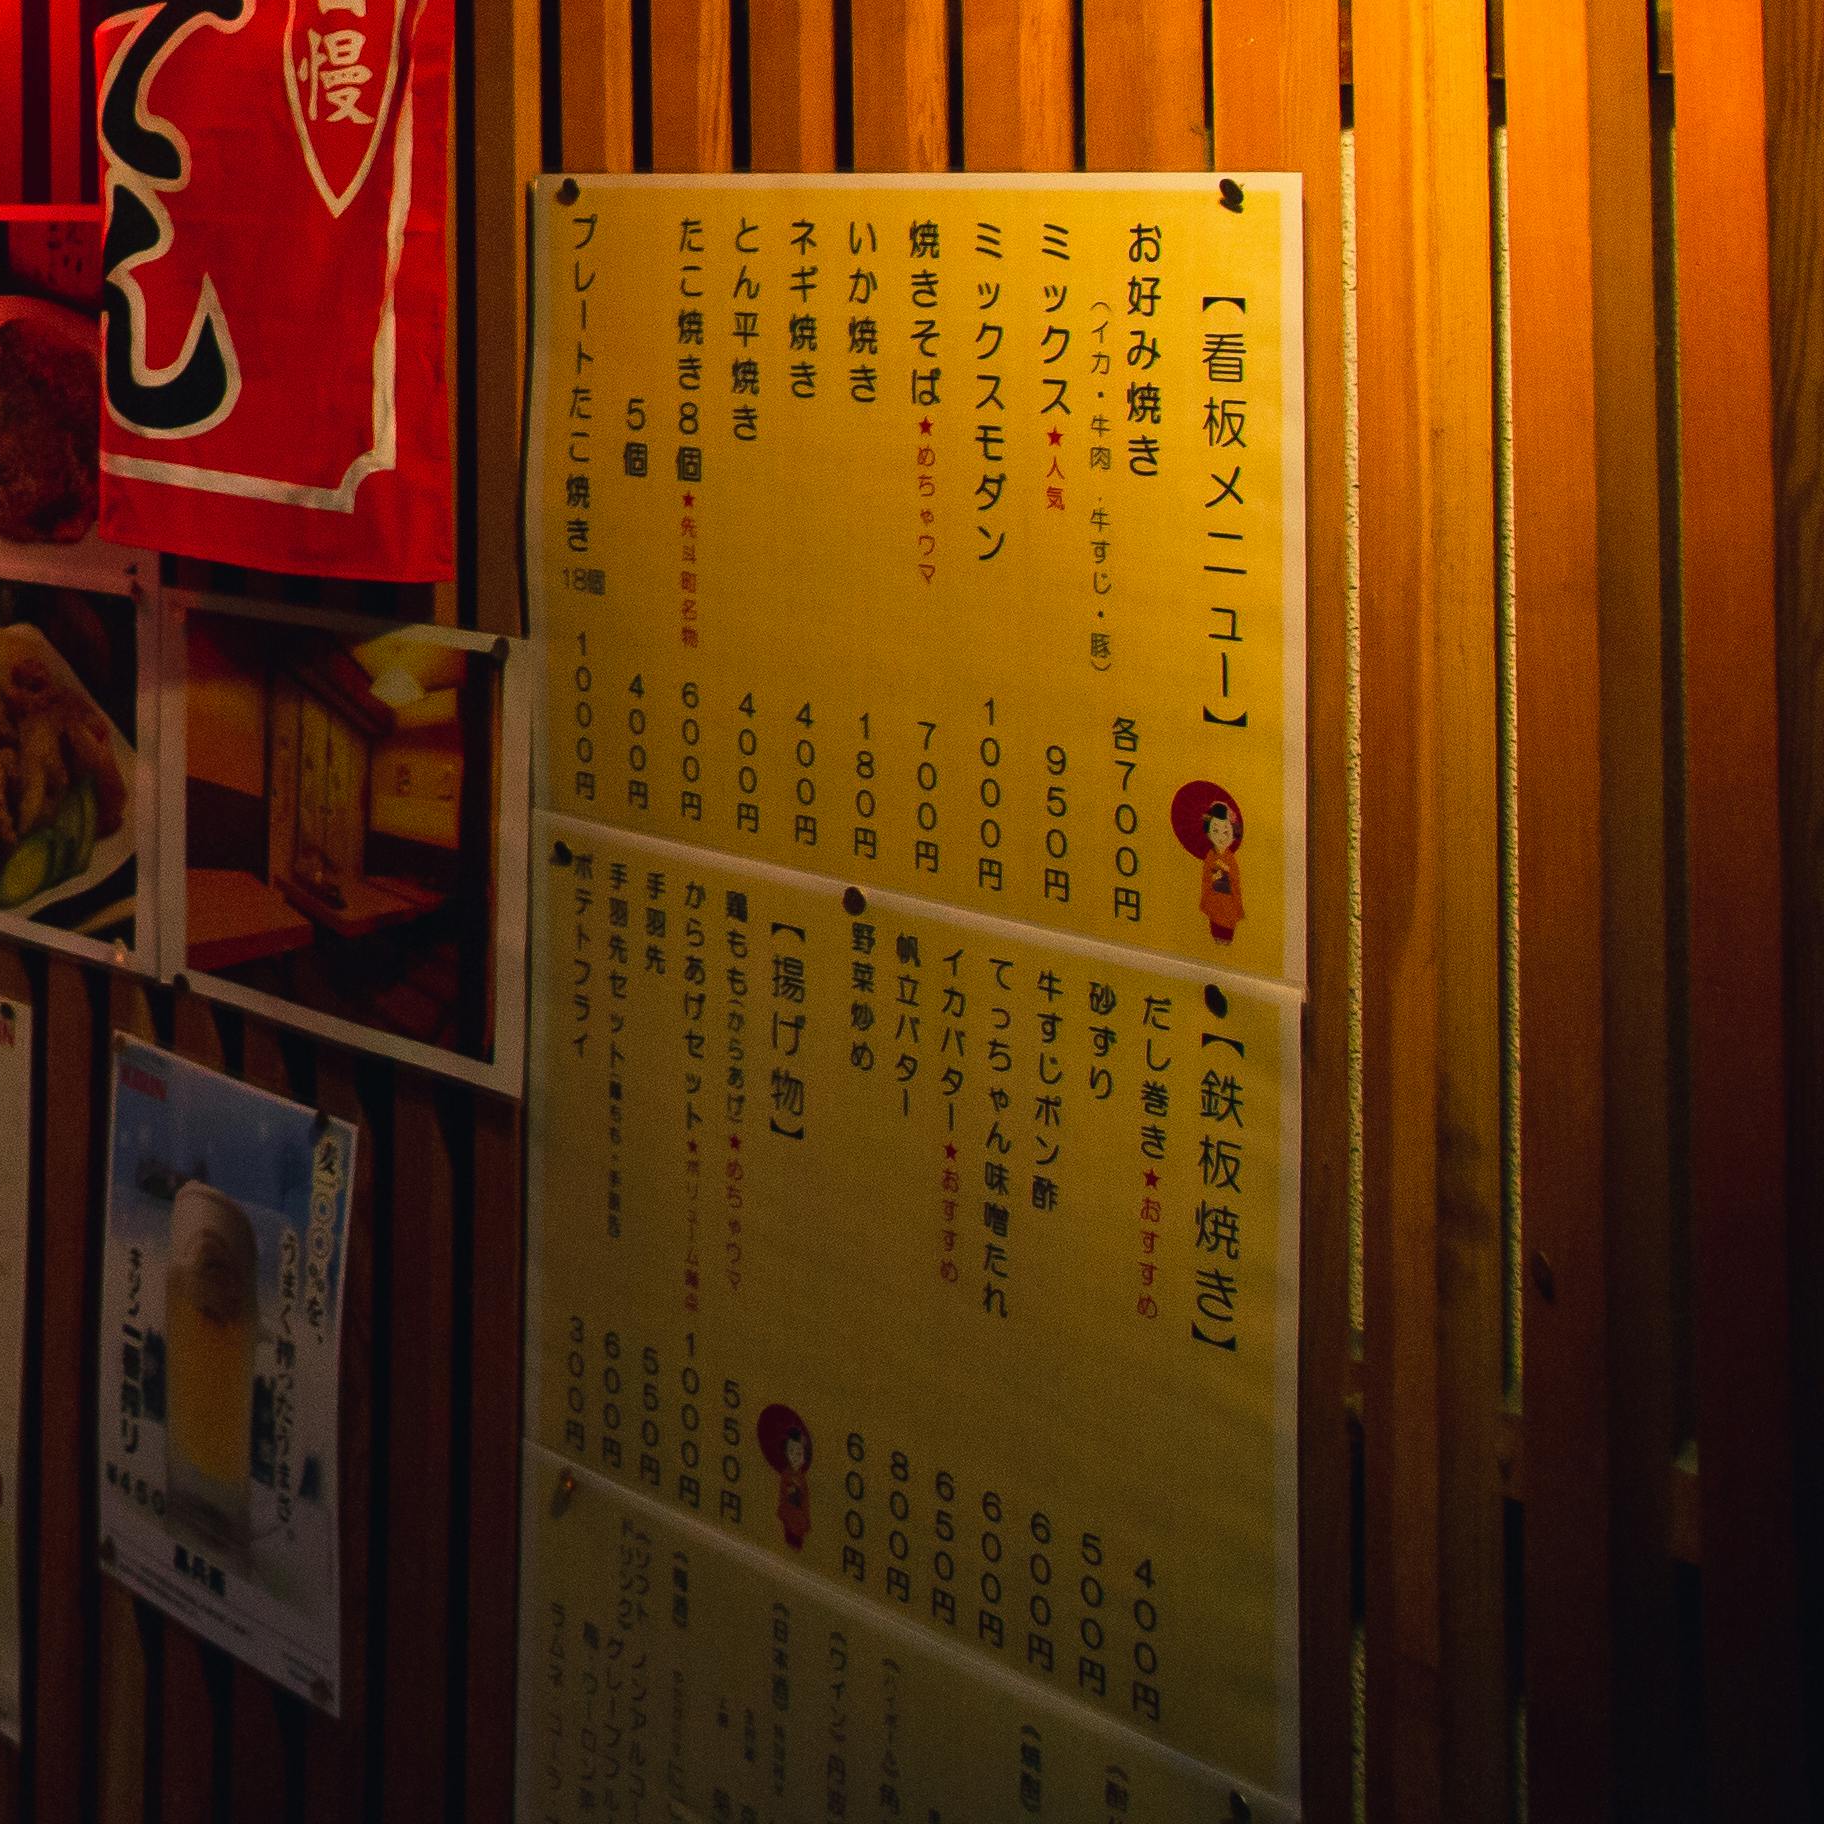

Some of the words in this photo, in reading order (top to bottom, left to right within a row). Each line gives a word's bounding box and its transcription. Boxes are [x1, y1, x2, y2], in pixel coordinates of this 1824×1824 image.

[565, 213, 598, 552] プレートたこ焼き
[675, 218, 704, 483] たこ焼き8個
[731, 218, 761, 442] とん平焼き
[788, 218, 818, 401] ネギ焼き
[847, 221, 879, 404] いか焼き
[909, 220, 941, 408] 焼きそば
[1041, 222, 1072, 417] ミックス
[1126, 223, 1163, 479] お好み焼き
[622, 399, 649, 479] 5個
[975, 222, 1008, 563] ミックスモダン
[1045, 456, 1066, 511] 人気
[1201, 294, 1249, 729] 【看板メニュー】
[574, 632, 596, 802] 1000円
[626, 674, 648, 810] 400円
[681, 682, 702, 822] 600円
[736, 693, 761, 834] 400円
[794, 702, 818, 846] 400円
[853, 712, 878, 861] 180円
[914, 721, 939, 874] 700円
[978, 698, 1004, 893] 1000円
[1043, 746, 1072, 904] 950円
[1111, 717, 1143, 924] 各700円
[571, 851, 596, 1059] ポテトフライ
[644, 870, 666, 976] 手羽先
[848, 922, 877, 1073] 野菜炒め
[681, 881, 706, 1131] からあげセット
[769, 922, 807, 1140] 【揚げ物】
[894, 933, 922, 1118] 帆立バター
[939, 948, 966, 1132] イカバター
[1087, 980, 1118, 1102] 砂ずり
[1140, 996, 1173, 1160] だし巻き
[980, 957, 1015, 1319] てっちゃん味噌たれ
[1032, 970, 1065, 1212] 牛すじポン酢
[939, 1167, 960, 1285] おすすめ
[1136, 1197, 1163, 1320] おすすめ
[1191, 1033, 1246, 1351] 【鉄板焼き】
[565, 1316, 587, 1452] 300円
[601, 1331, 623, 1470] 600円
[639, 1346, 661, 1488] 550円
[678, 1332, 700, 1510] 1000円
[719, 1380, 743, 1524] 550円
[843, 1433, 867, 1583] 600円
[887, 1451, 911, 1604] 800円
[932, 1470, 954, 1627] 650円
[978, 1491, 1006, 1649] 600円
[1028, 1511, 1054, 1674] 600円
[1079, 1533, 1107, 1697] 500円
[1131, 1559, 1161, 1723] 400円
